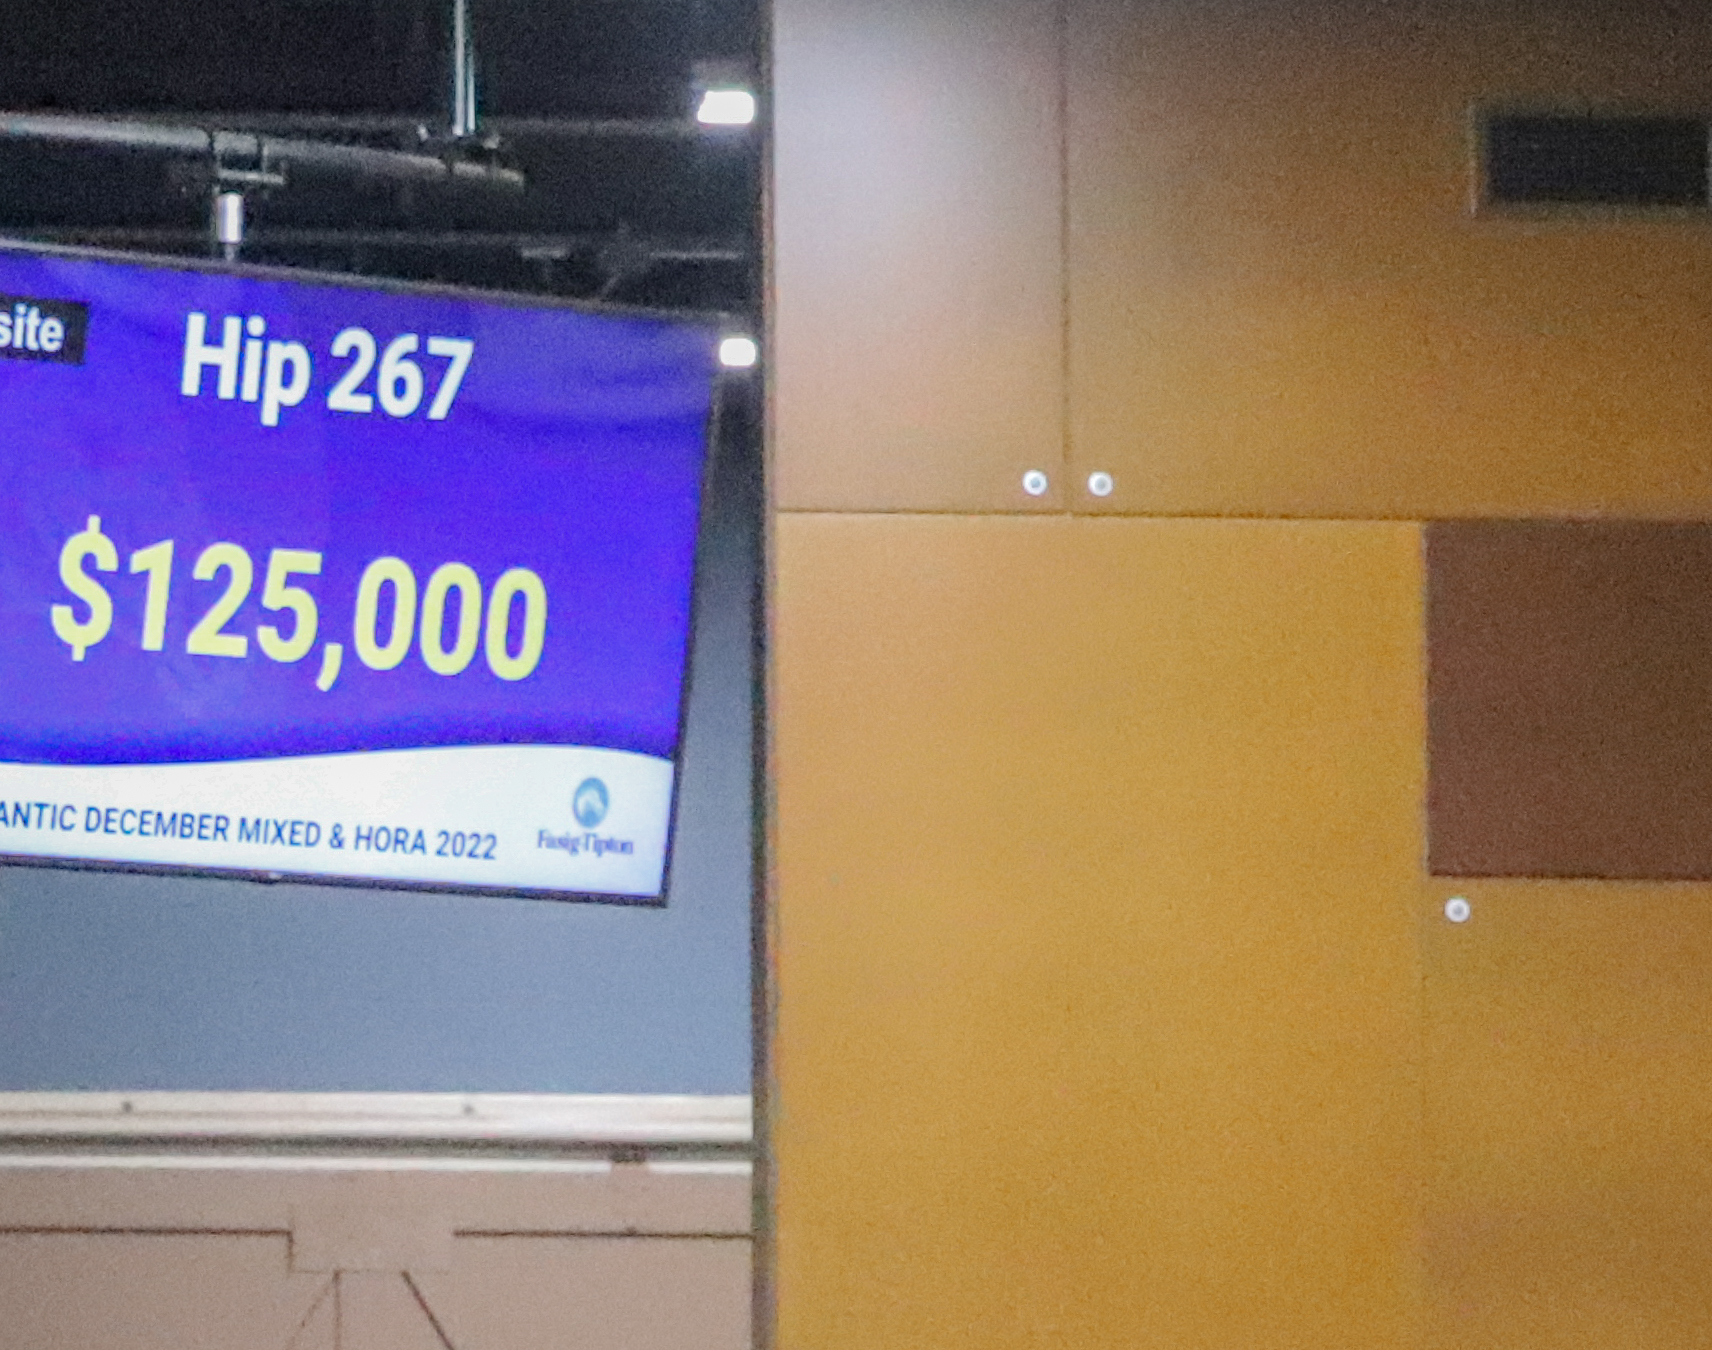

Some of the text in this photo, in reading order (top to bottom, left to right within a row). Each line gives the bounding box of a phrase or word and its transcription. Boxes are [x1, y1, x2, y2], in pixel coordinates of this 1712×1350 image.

[181, 312, 474, 426] Hip 267
[50, 515, 548, 692] $125,000
[83, 805, 231, 842] DECEMBER
[237, 816, 322, 849] MIXED
[327, 821, 346, 850] &
[353, 824, 428, 856] HORA
[434, 830, 498, 861] 2022
